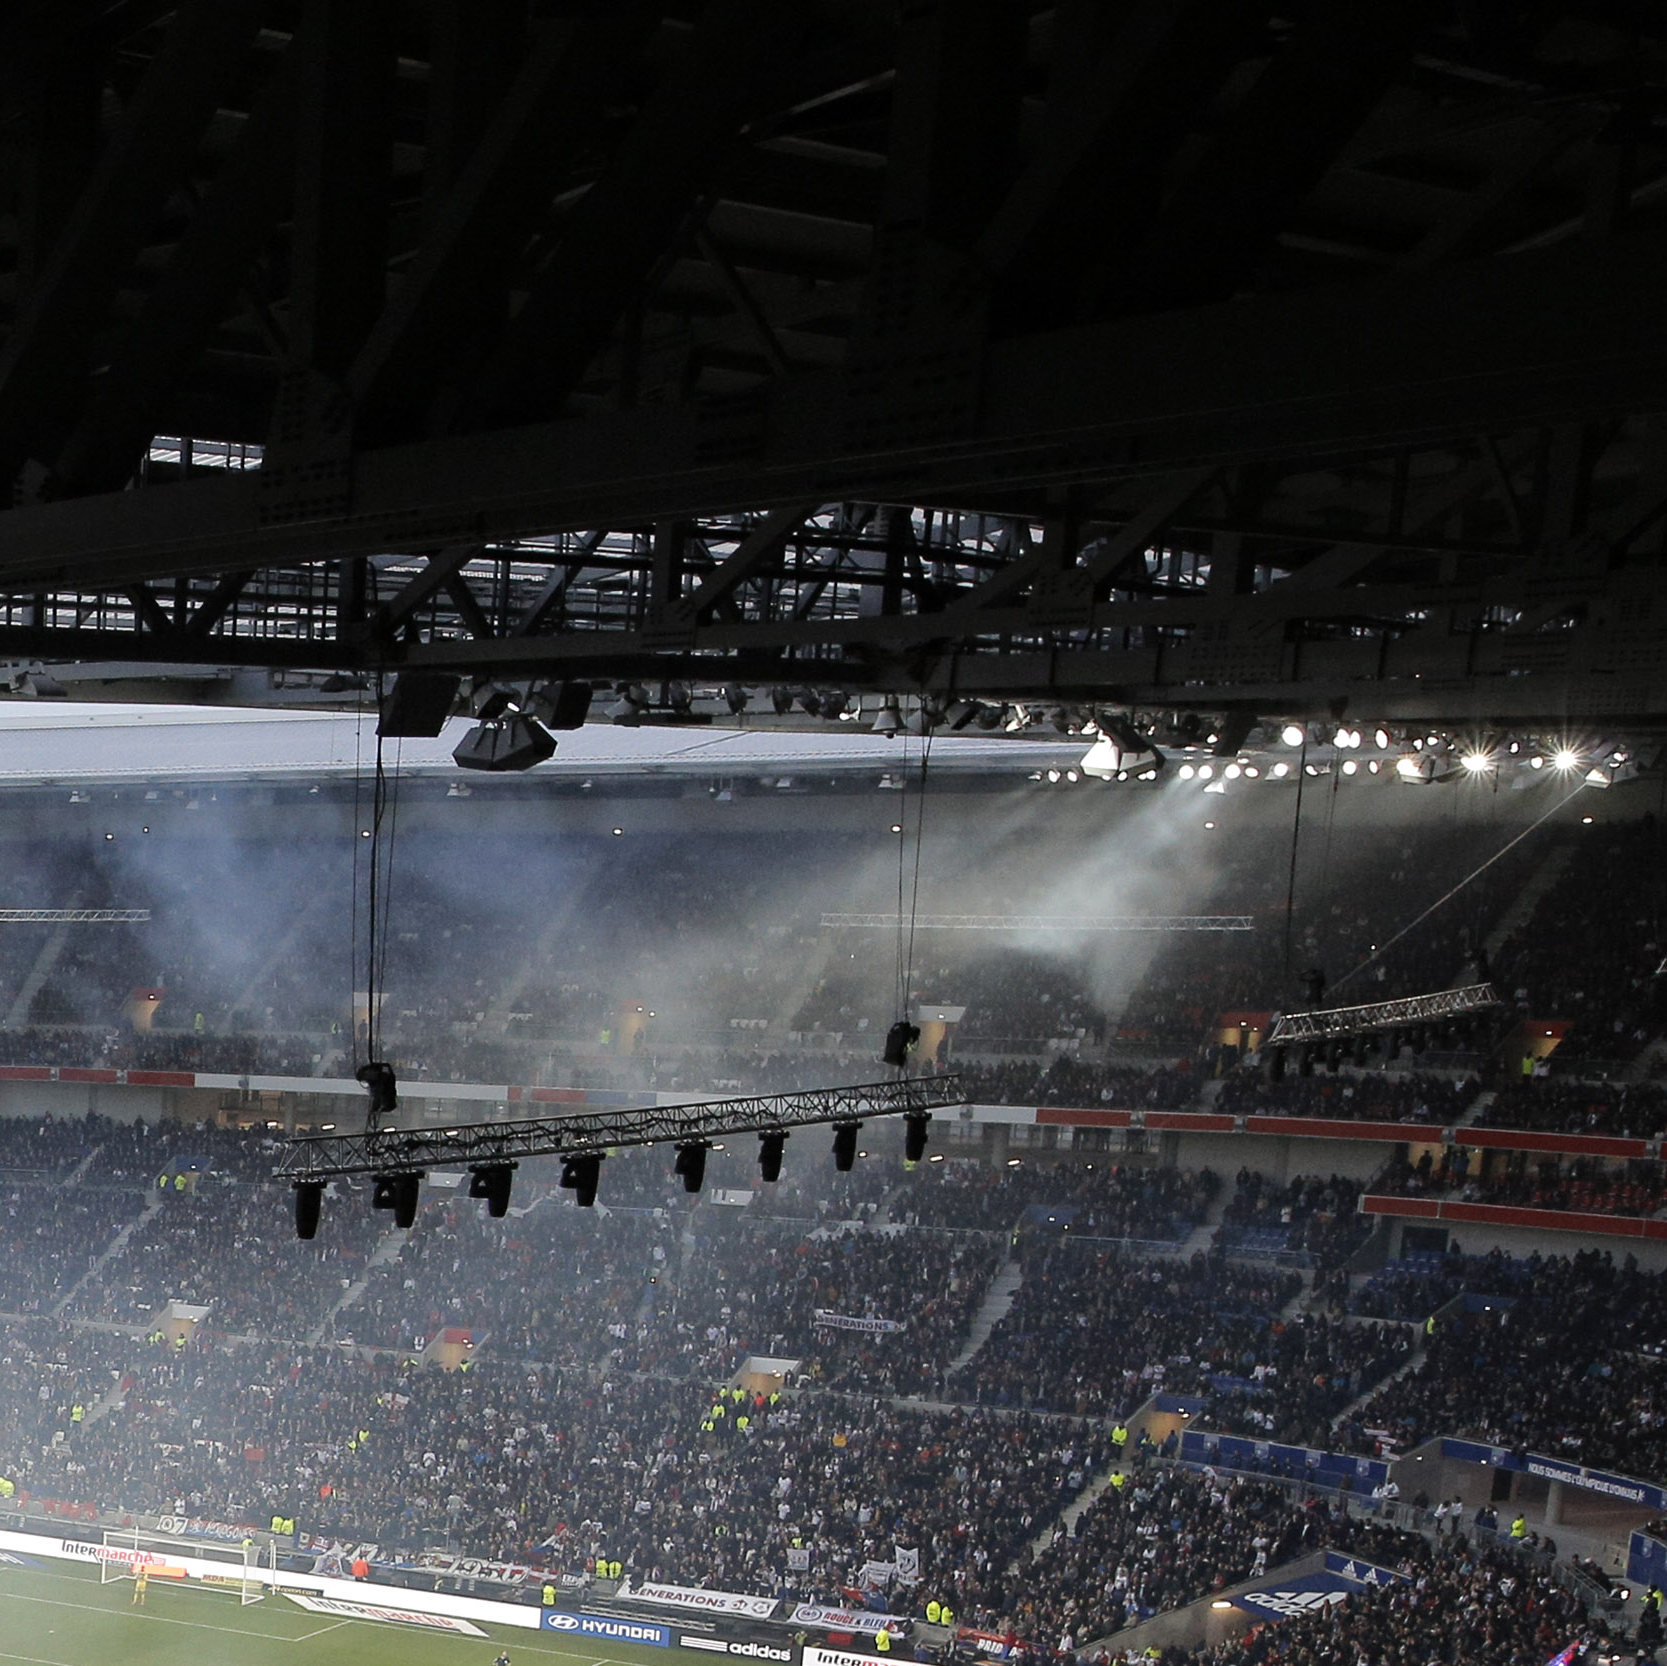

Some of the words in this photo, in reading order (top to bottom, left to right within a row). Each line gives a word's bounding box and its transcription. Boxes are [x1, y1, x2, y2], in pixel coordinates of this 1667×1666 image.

[61, 1540, 154, 1565] Intermarché
[628, 1588, 727, 1609] GENERATIONS
[823, 1612, 854, 1625] ROUGE
[582, 1619, 661, 1642] HYUNDAI
[729, 1642, 791, 1662] adidas
